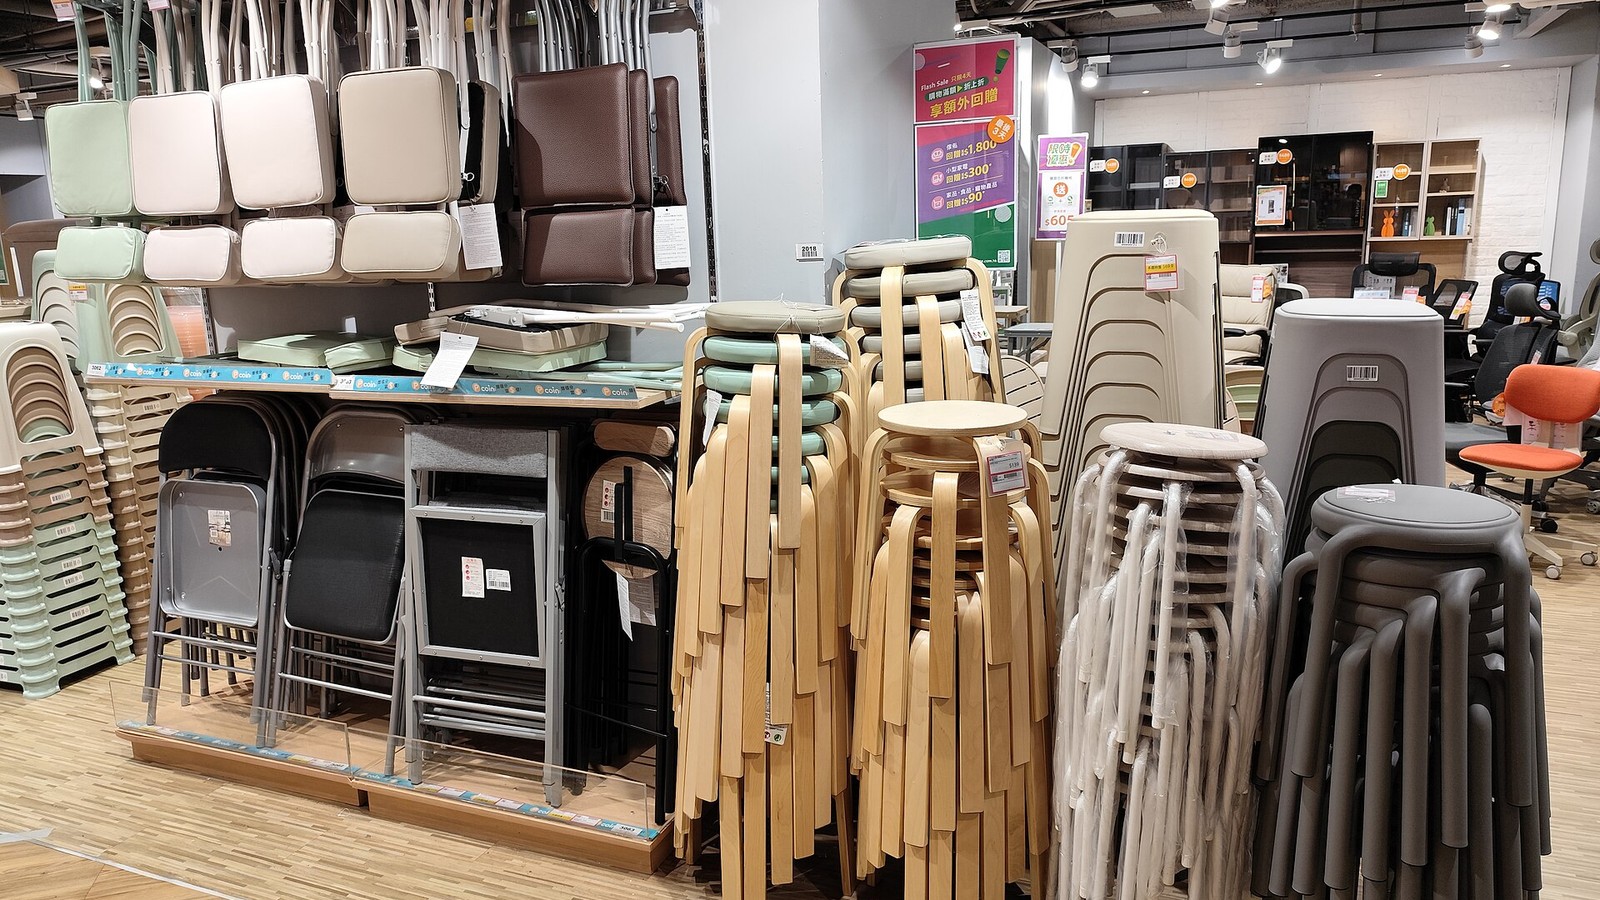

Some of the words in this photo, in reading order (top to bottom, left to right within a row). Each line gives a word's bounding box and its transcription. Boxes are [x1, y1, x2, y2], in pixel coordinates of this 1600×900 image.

[920, 81, 936, 91] Flash
[936, 79, 949, 88] Sale
[963, 77, 985, 91] 折上折
[930, 87, 998, 118] 享額外回贈
